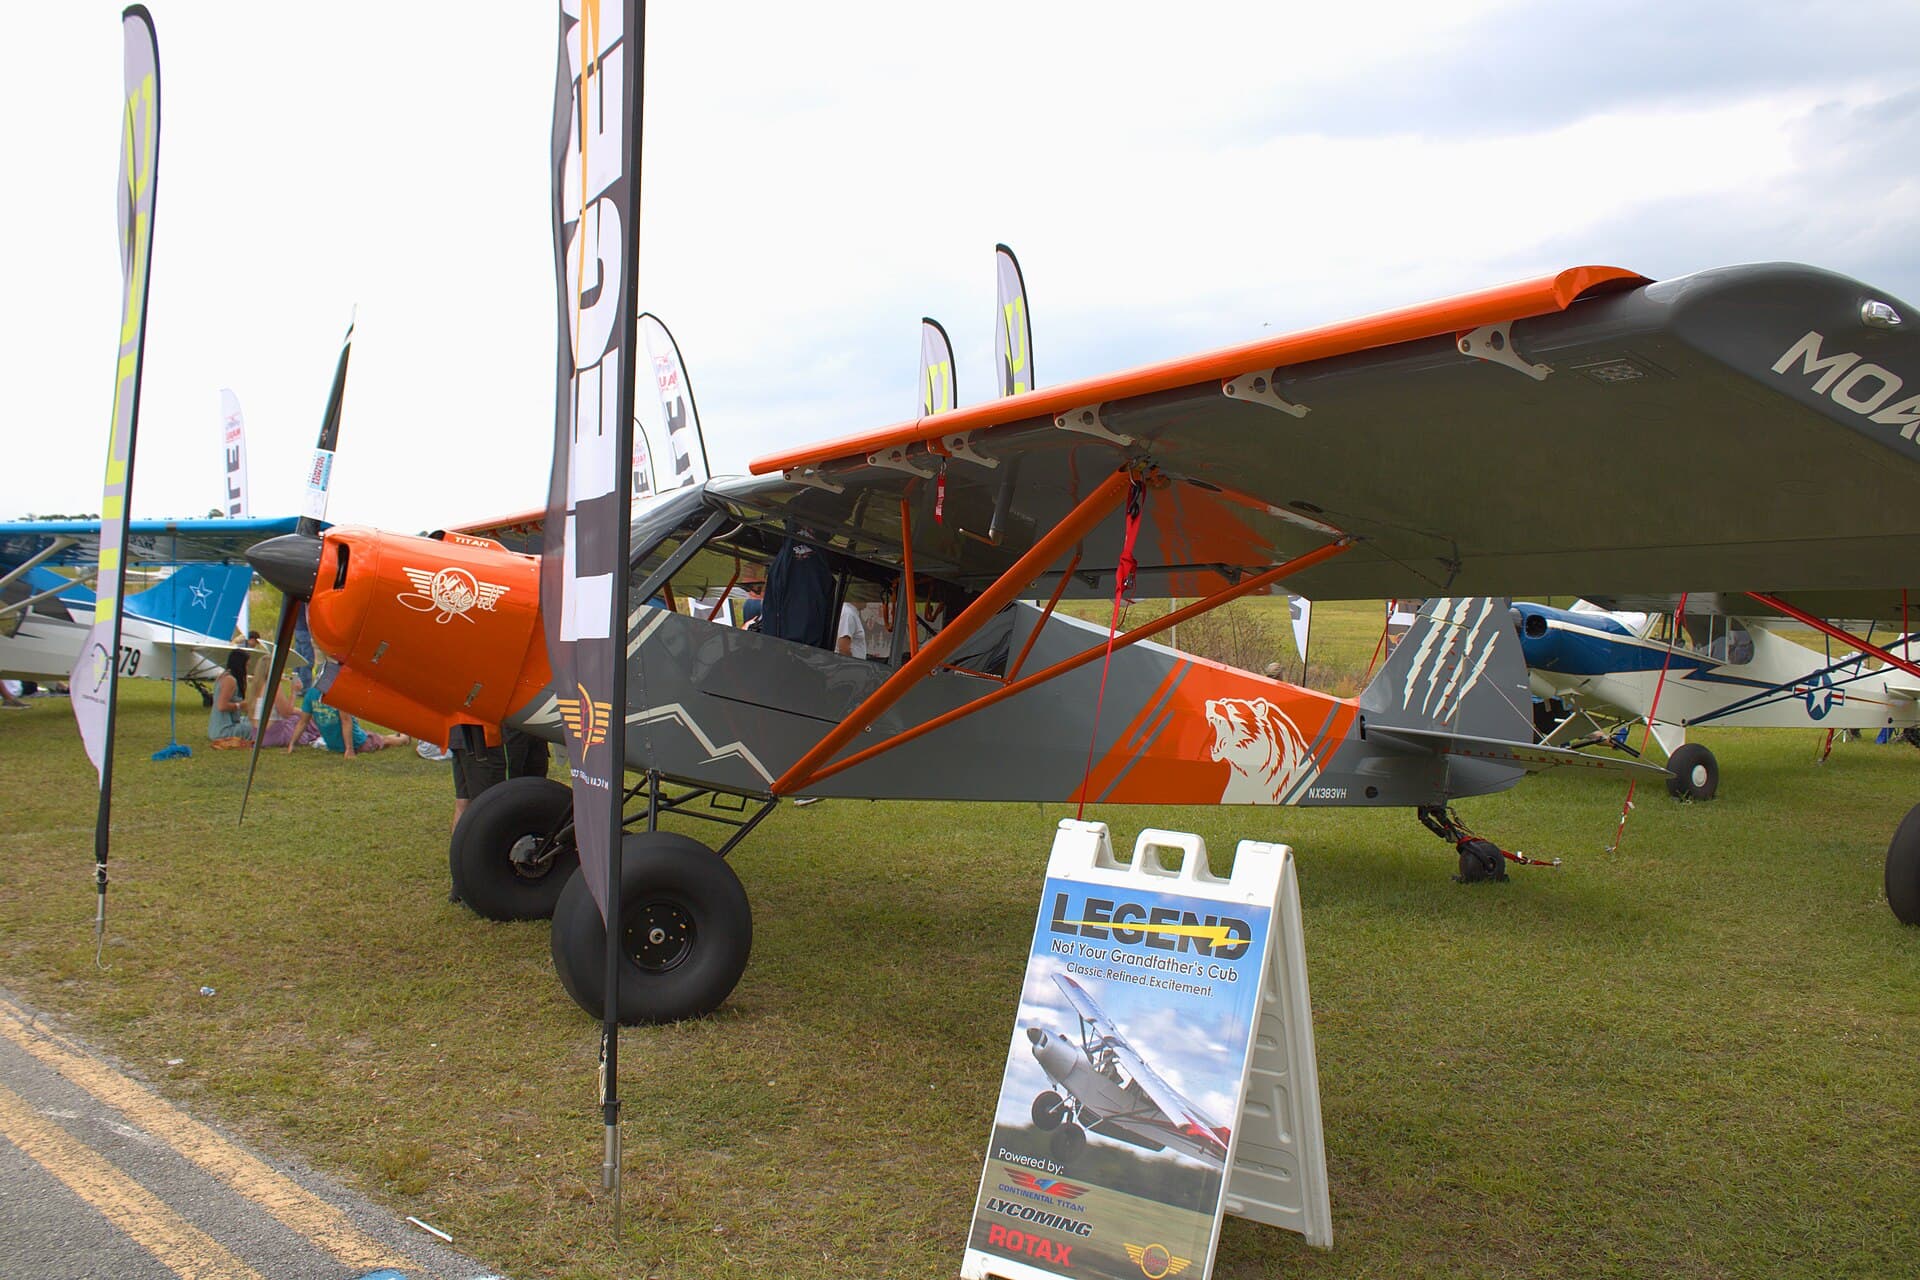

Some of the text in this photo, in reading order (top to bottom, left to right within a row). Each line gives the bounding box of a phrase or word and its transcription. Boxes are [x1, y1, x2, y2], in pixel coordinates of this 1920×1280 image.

[1771, 330, 1920, 445] MOA
[454, 536, 489, 548] TITAN
[1308, 787, 1347, 799] NX383VH
[1050, 893, 1252, 961] LEGEND
[1051, 939, 1238, 982] Not Your Grandfather's Cub
[998, 1148, 1064, 1175] Powered by:
[985, 1197, 1093, 1237] LYCOMING
[998, 1183, 1085, 1213] CONTINENTAL TITAN
[988, 1223, 1073, 1267] ROTAX
